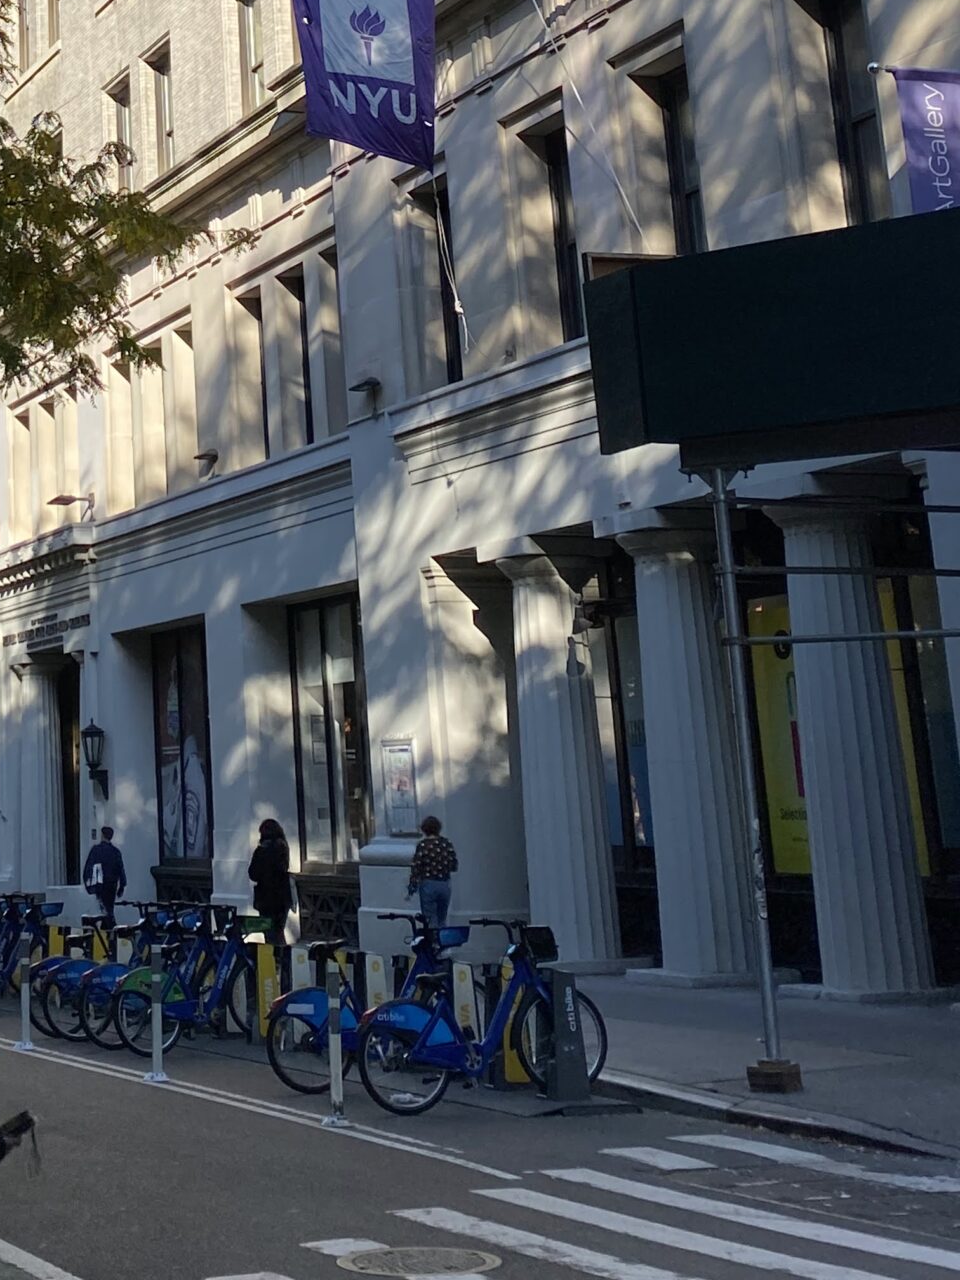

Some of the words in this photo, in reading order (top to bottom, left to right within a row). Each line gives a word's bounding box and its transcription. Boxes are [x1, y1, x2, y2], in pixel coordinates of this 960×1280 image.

[328, 79, 417, 124] NYU
[565, 986, 575, 1012] bike
[567, 1012, 577, 1032] citi
